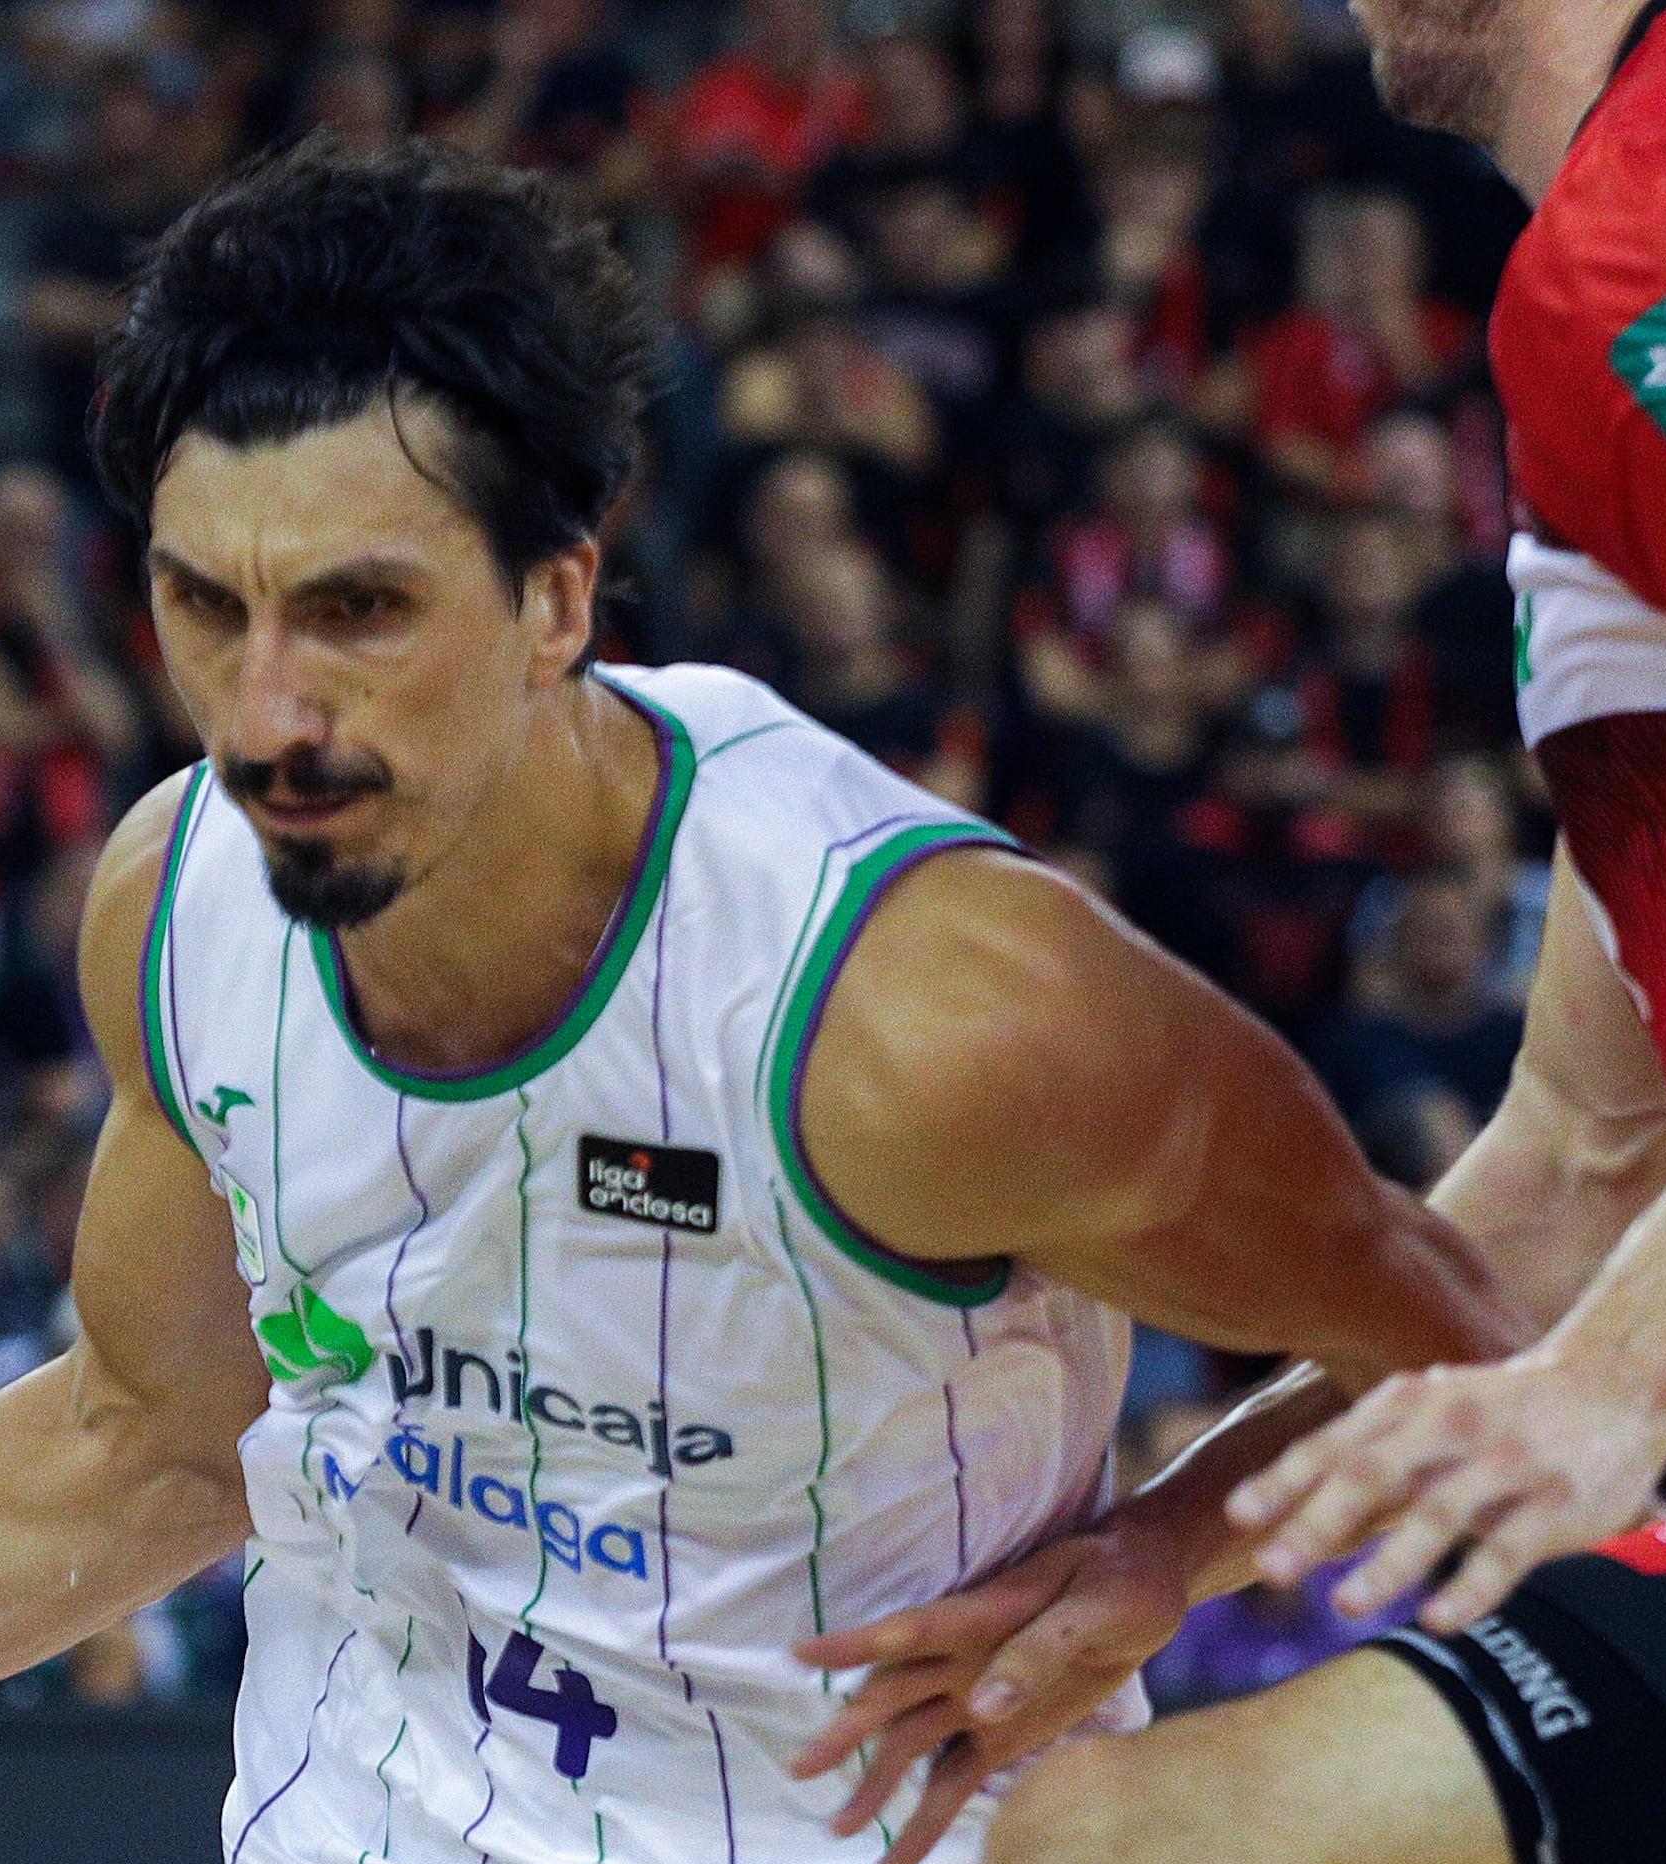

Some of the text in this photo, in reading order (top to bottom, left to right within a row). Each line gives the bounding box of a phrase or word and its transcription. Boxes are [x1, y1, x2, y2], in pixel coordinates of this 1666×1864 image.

[589, 1158, 647, 1198] liga
[589, 1186, 713, 1228] endesa
[386, 1326, 733, 1478] Unicaja
[1467, 1614, 1593, 1742] LDING
